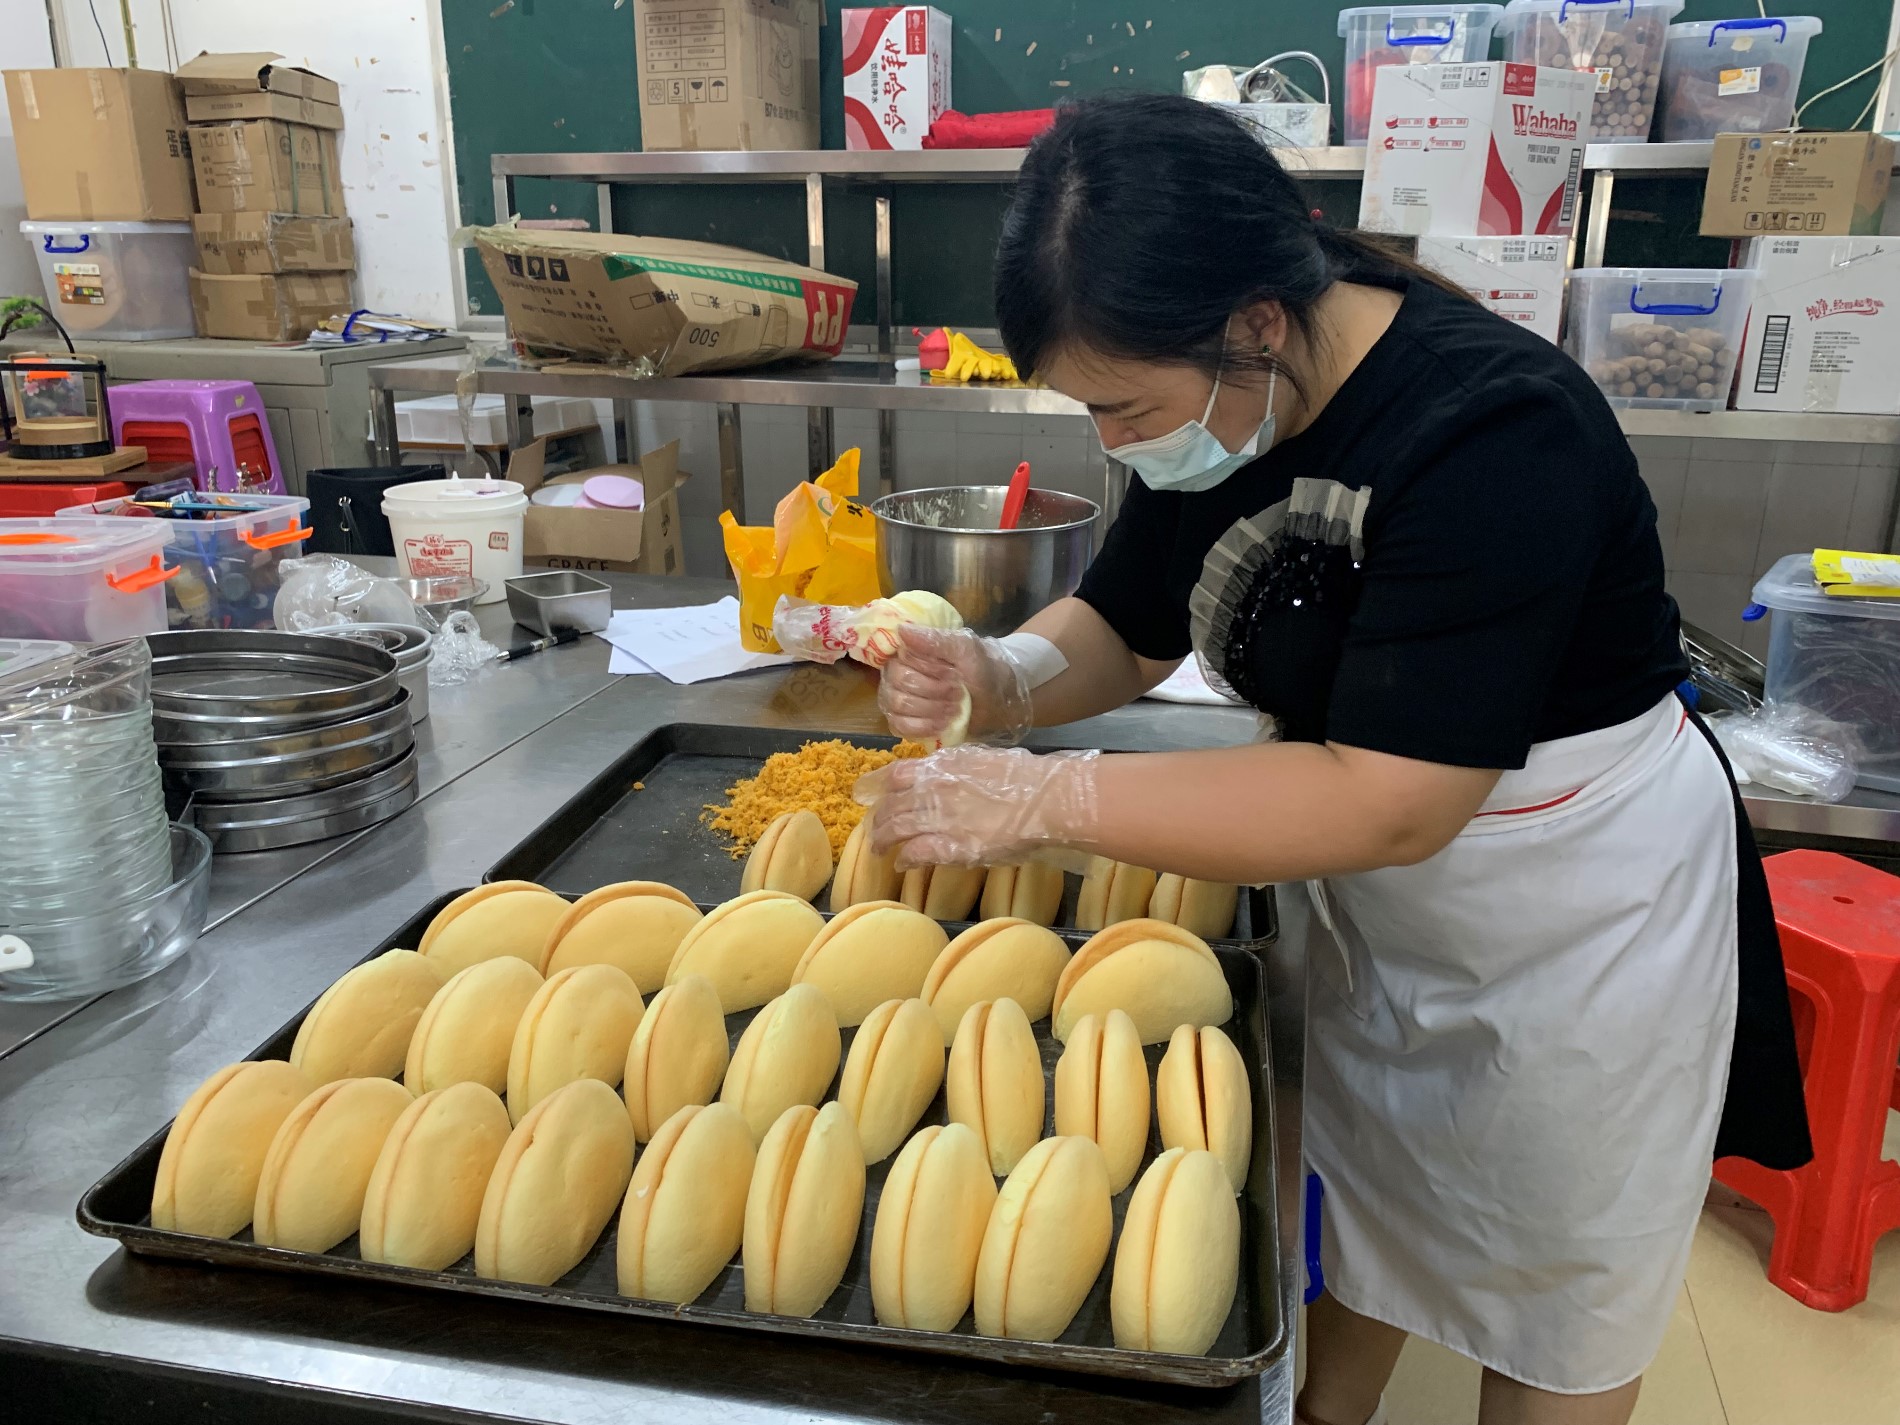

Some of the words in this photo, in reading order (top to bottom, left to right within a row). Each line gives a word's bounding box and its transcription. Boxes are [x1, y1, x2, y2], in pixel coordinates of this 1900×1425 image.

[673, 82, 680, 95] 5
[870, 62, 879, 104] 饮用纯净水
[880, 38, 907, 134] 娃哈哈
[1512, 104, 1577, 140] Wahaha
[689, 327, 720, 348] 500
[812, 291, 844, 346] PP
